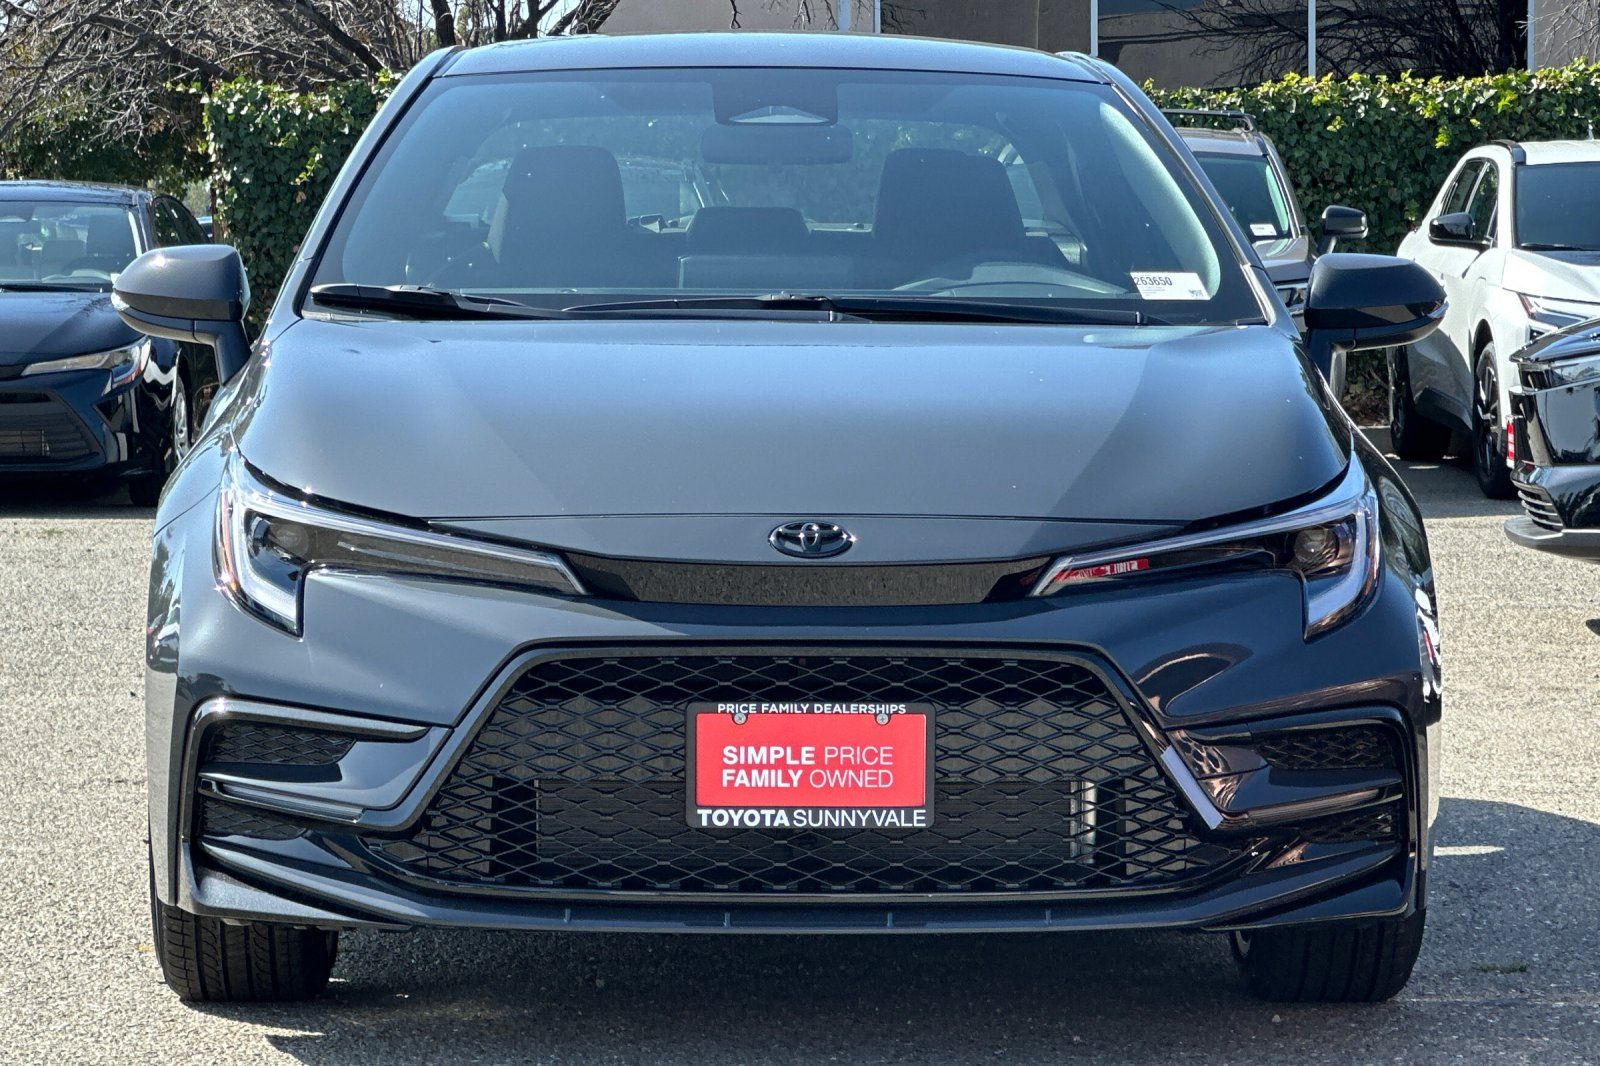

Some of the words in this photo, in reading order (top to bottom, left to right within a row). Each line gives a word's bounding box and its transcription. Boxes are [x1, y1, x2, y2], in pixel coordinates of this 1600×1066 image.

[1134, 276, 1173, 286] 263650
[717, 704, 756, 714] PRICE
[761, 704, 809, 714] FAMILY
[813, 704, 906, 714] DEALERSHIPS
[723, 746, 815, 765] SIMPLE
[824, 746, 894, 765] PRICE
[722, 769, 803, 788] FAMILY
[809, 769, 893, 788] OWNED
[697, 809, 789, 827] TOYOTA
[793, 809, 926, 827] SUNNYVALE
